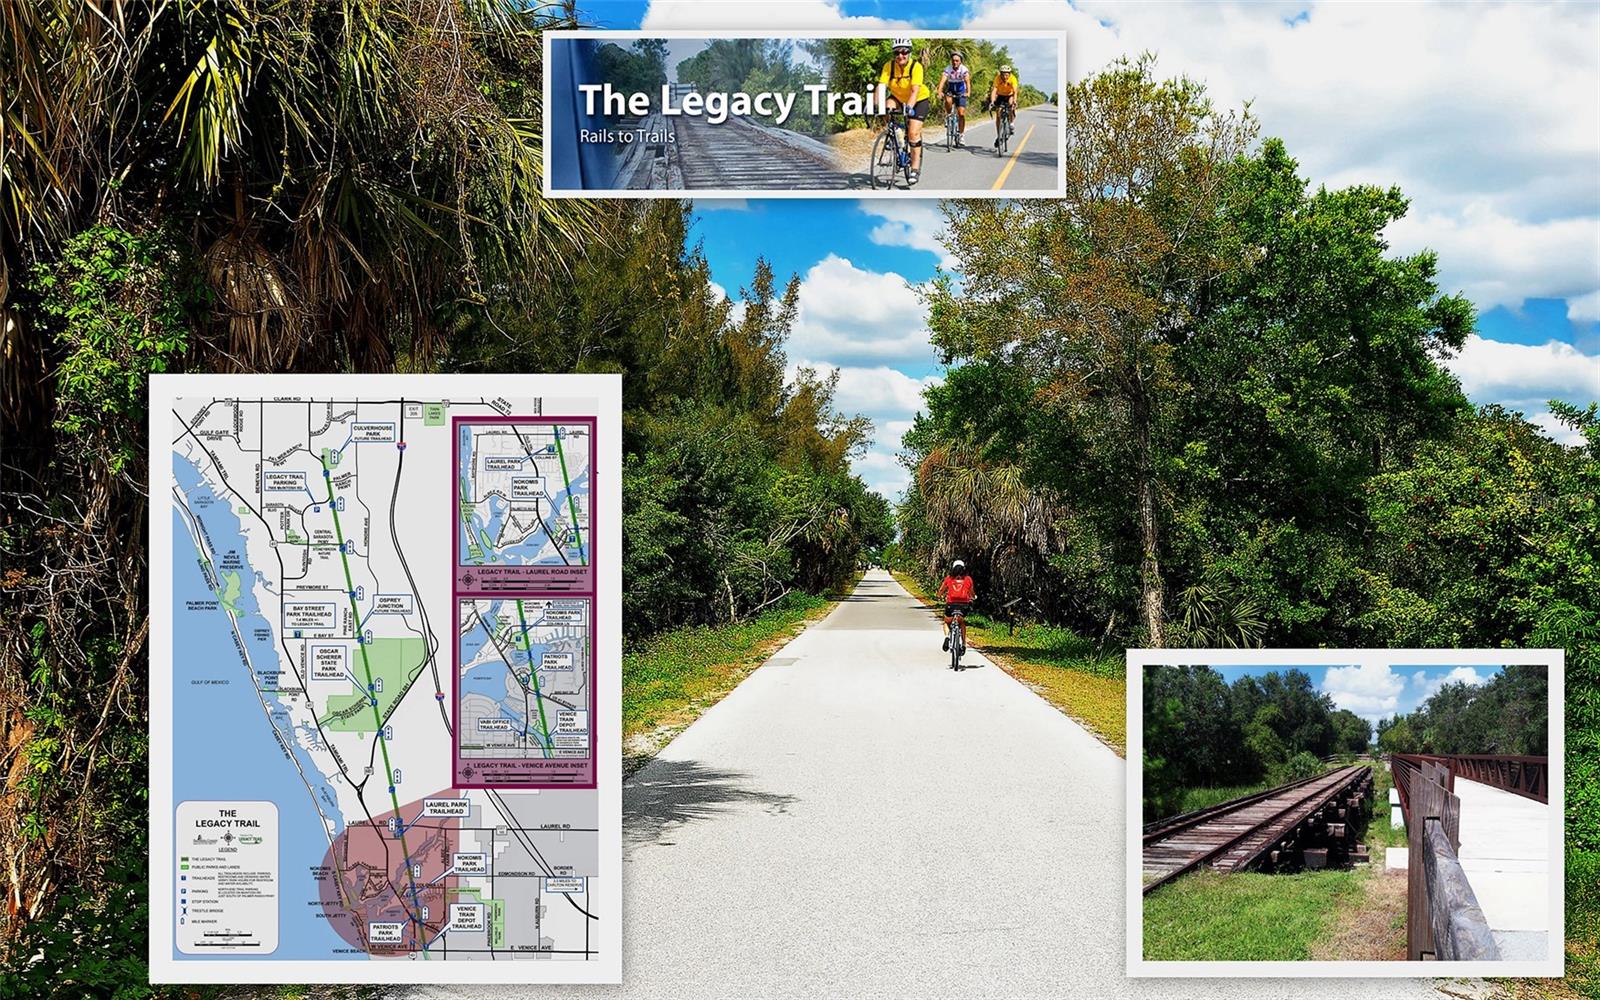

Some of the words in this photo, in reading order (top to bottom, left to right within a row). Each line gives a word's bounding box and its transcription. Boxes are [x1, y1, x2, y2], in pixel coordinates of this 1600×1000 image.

[578, 84, 649, 117] The
[662, 84, 796, 126] Legacy
[804, 84, 886, 117] Trail
[580, 129, 614, 143] Rails
[618, 131, 633, 143] to
[636, 129, 675, 143] Trails
[491, 400, 505, 411] ROAD
[497, 397, 512, 409] STATE
[190, 406, 206, 424] STICKNEY
[195, 416, 206, 428] POINT
[210, 450, 224, 471] TAMIAMI
[221, 470, 229, 480] TRL
[256, 464, 260, 472] RD
[333, 472, 351, 481] PALMER
[383, 706, 392, 719] STATE
[391, 694, 402, 708] ROAD
[330, 744, 344, 763] TAMIAMI
